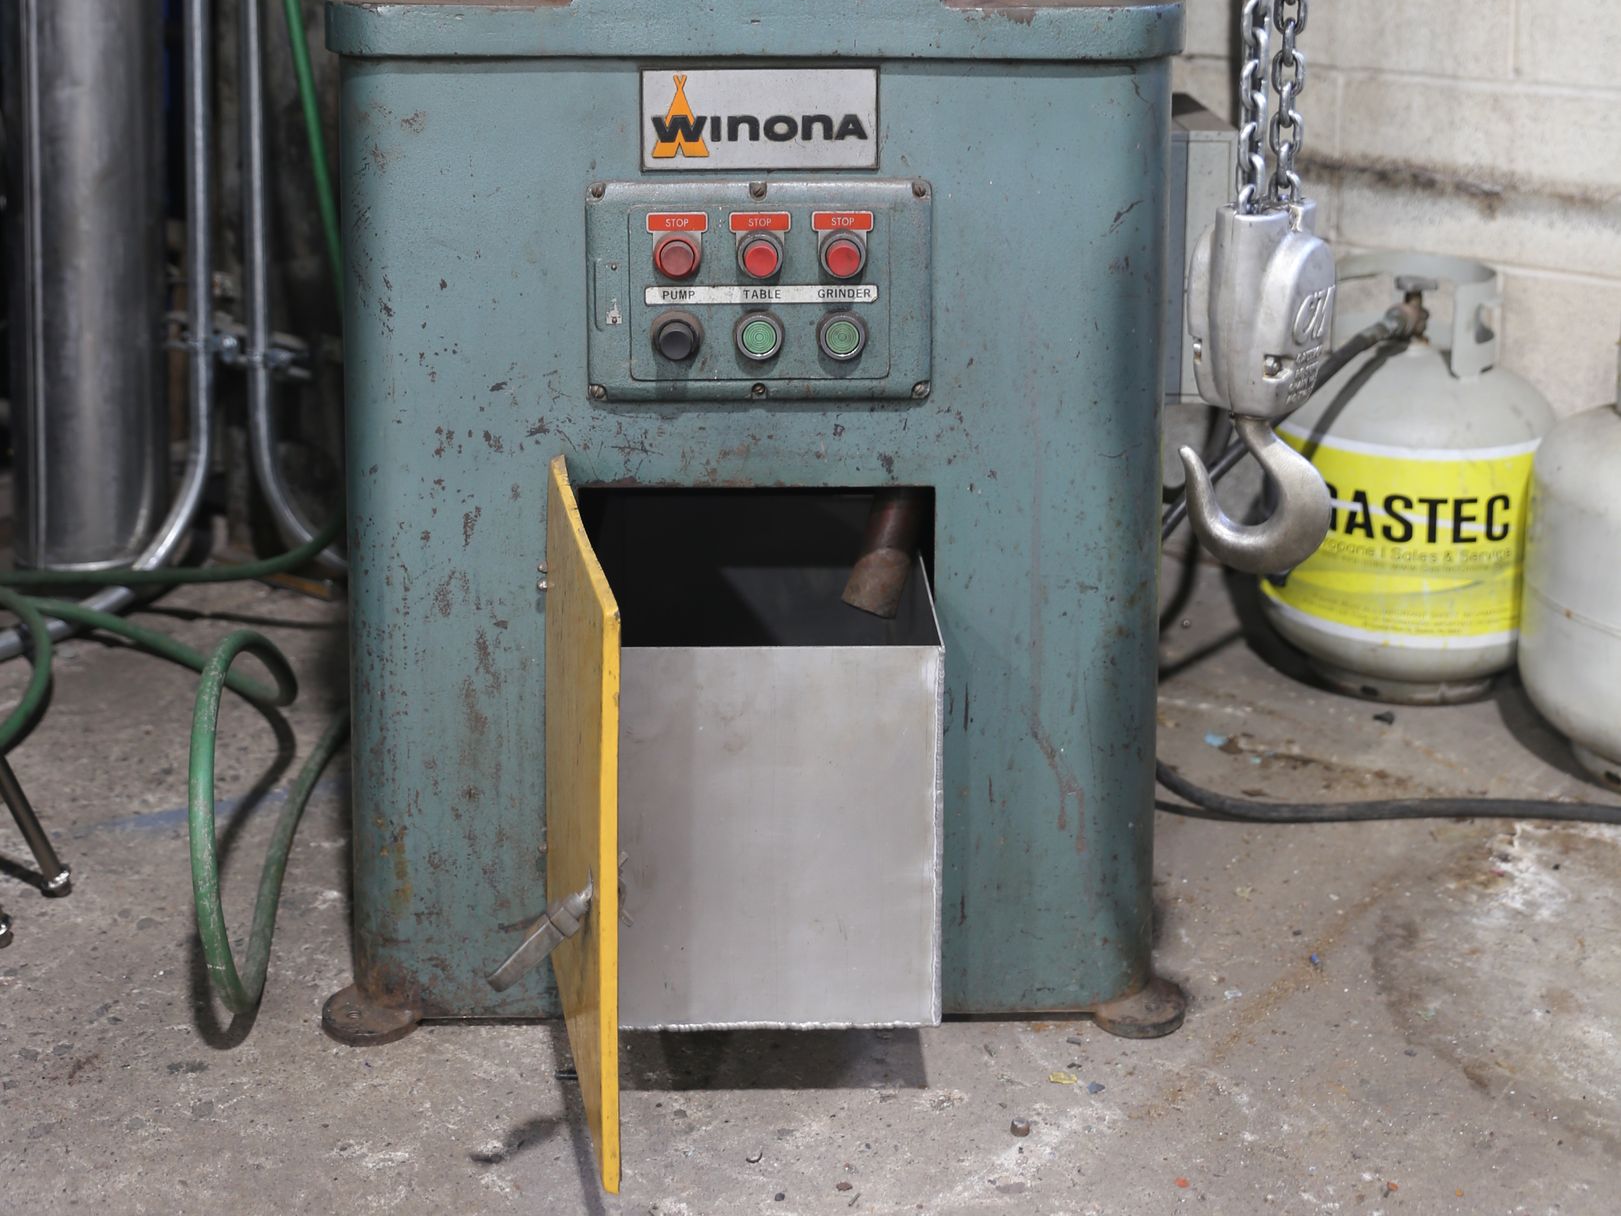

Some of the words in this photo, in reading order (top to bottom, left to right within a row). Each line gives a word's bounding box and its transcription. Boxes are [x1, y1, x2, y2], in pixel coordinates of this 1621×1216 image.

[665, 217, 689, 228] STOP
[748, 217, 772, 227] STOP
[831, 216, 855, 226] STOP
[662, 290, 695, 300] PUMP
[743, 289, 781, 300] TABLE
[817, 288, 871, 299] GRINDER
[1391, 547, 1437, 564] Sales
